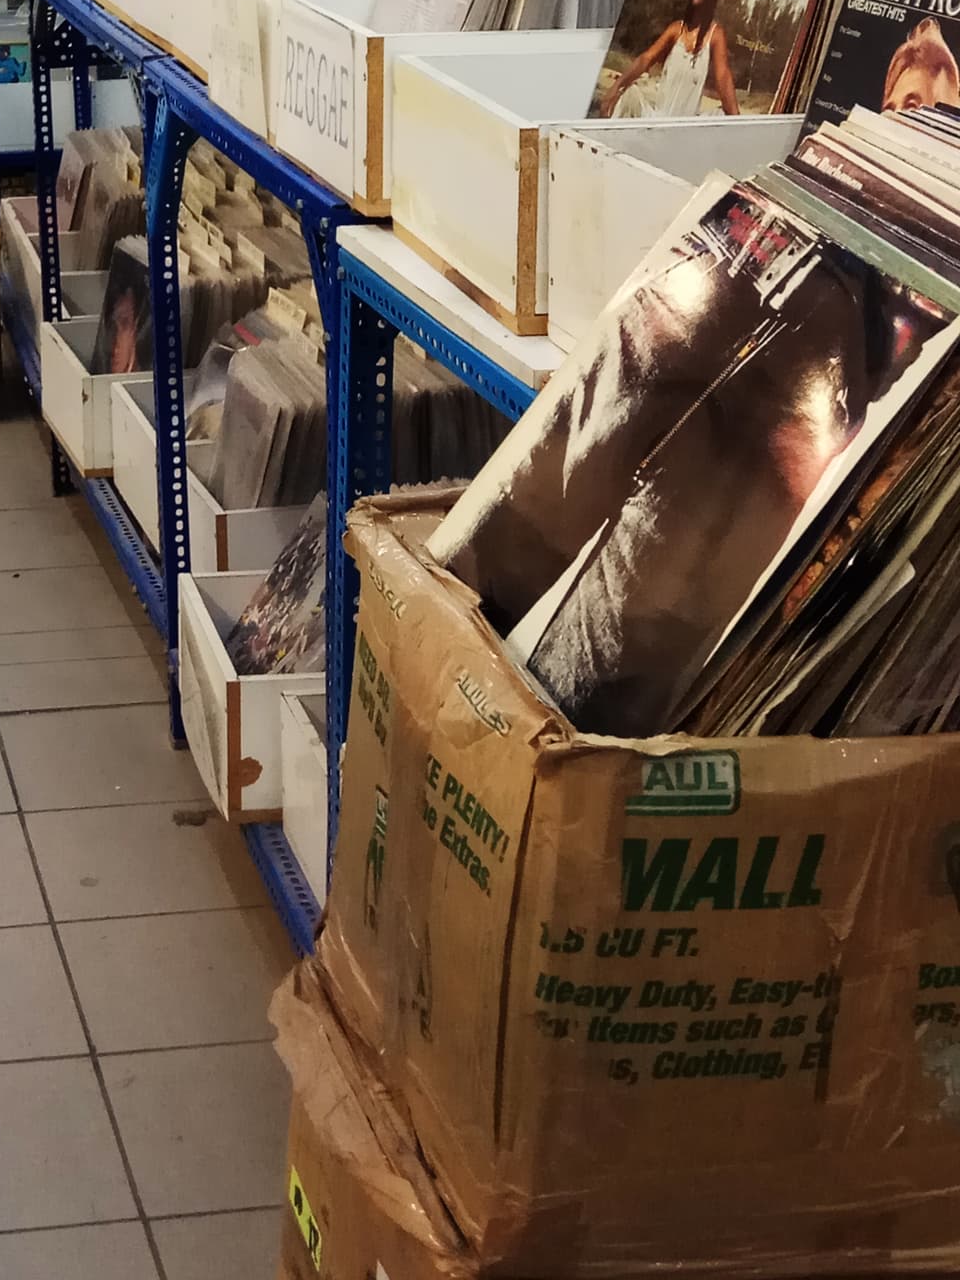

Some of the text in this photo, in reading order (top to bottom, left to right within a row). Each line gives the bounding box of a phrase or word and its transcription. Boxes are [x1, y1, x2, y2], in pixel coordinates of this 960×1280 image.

[886, 5, 908, 23] HITS
[283, 35, 349, 150] REGGAE
[442, 772, 510, 864] PLENTY!
[621, 833, 826, 913] MALL
[638, 979, 719, 1013] Duty,
[685, 1013, 763, 1042] such
[769, 1015, 810, 1038] as
[651, 1048, 788, 1081] Clothing,
